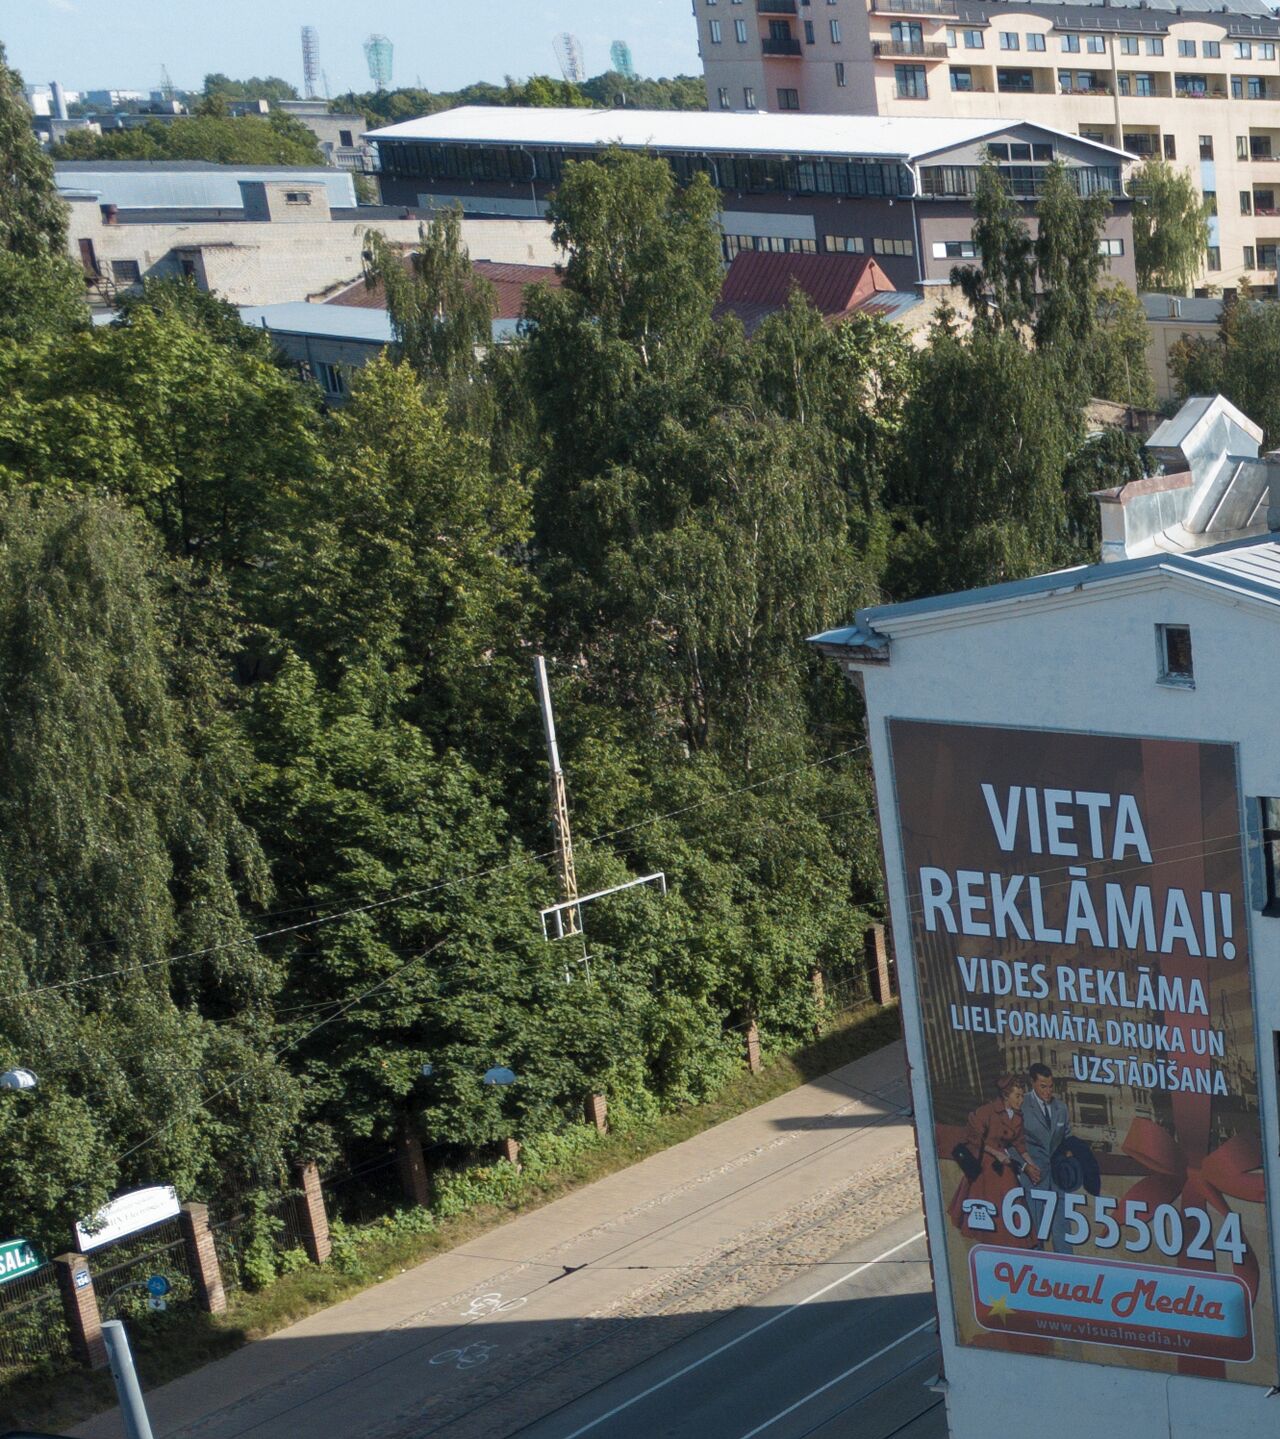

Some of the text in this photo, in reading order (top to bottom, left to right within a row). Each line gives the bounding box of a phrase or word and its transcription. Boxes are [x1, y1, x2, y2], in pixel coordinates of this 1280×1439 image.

[980, 783, 1153, 864] VIETA
[919, 866, 1238, 961] REKLĀMAI!
[957, 955, 1209, 1016] VIDES REKLĀMA
[950, 1003, 1225, 1057] LIELFORMĀTA DRUKA UN
[1072, 1052, 1229, 1096] UZSTĀDĪŠANA
[1001, 1186, 1247, 1265] 67555024
[993, 1261, 1226, 1321] Visual Media
[1035, 1317, 1192, 1349] www.visualmedia.lv
